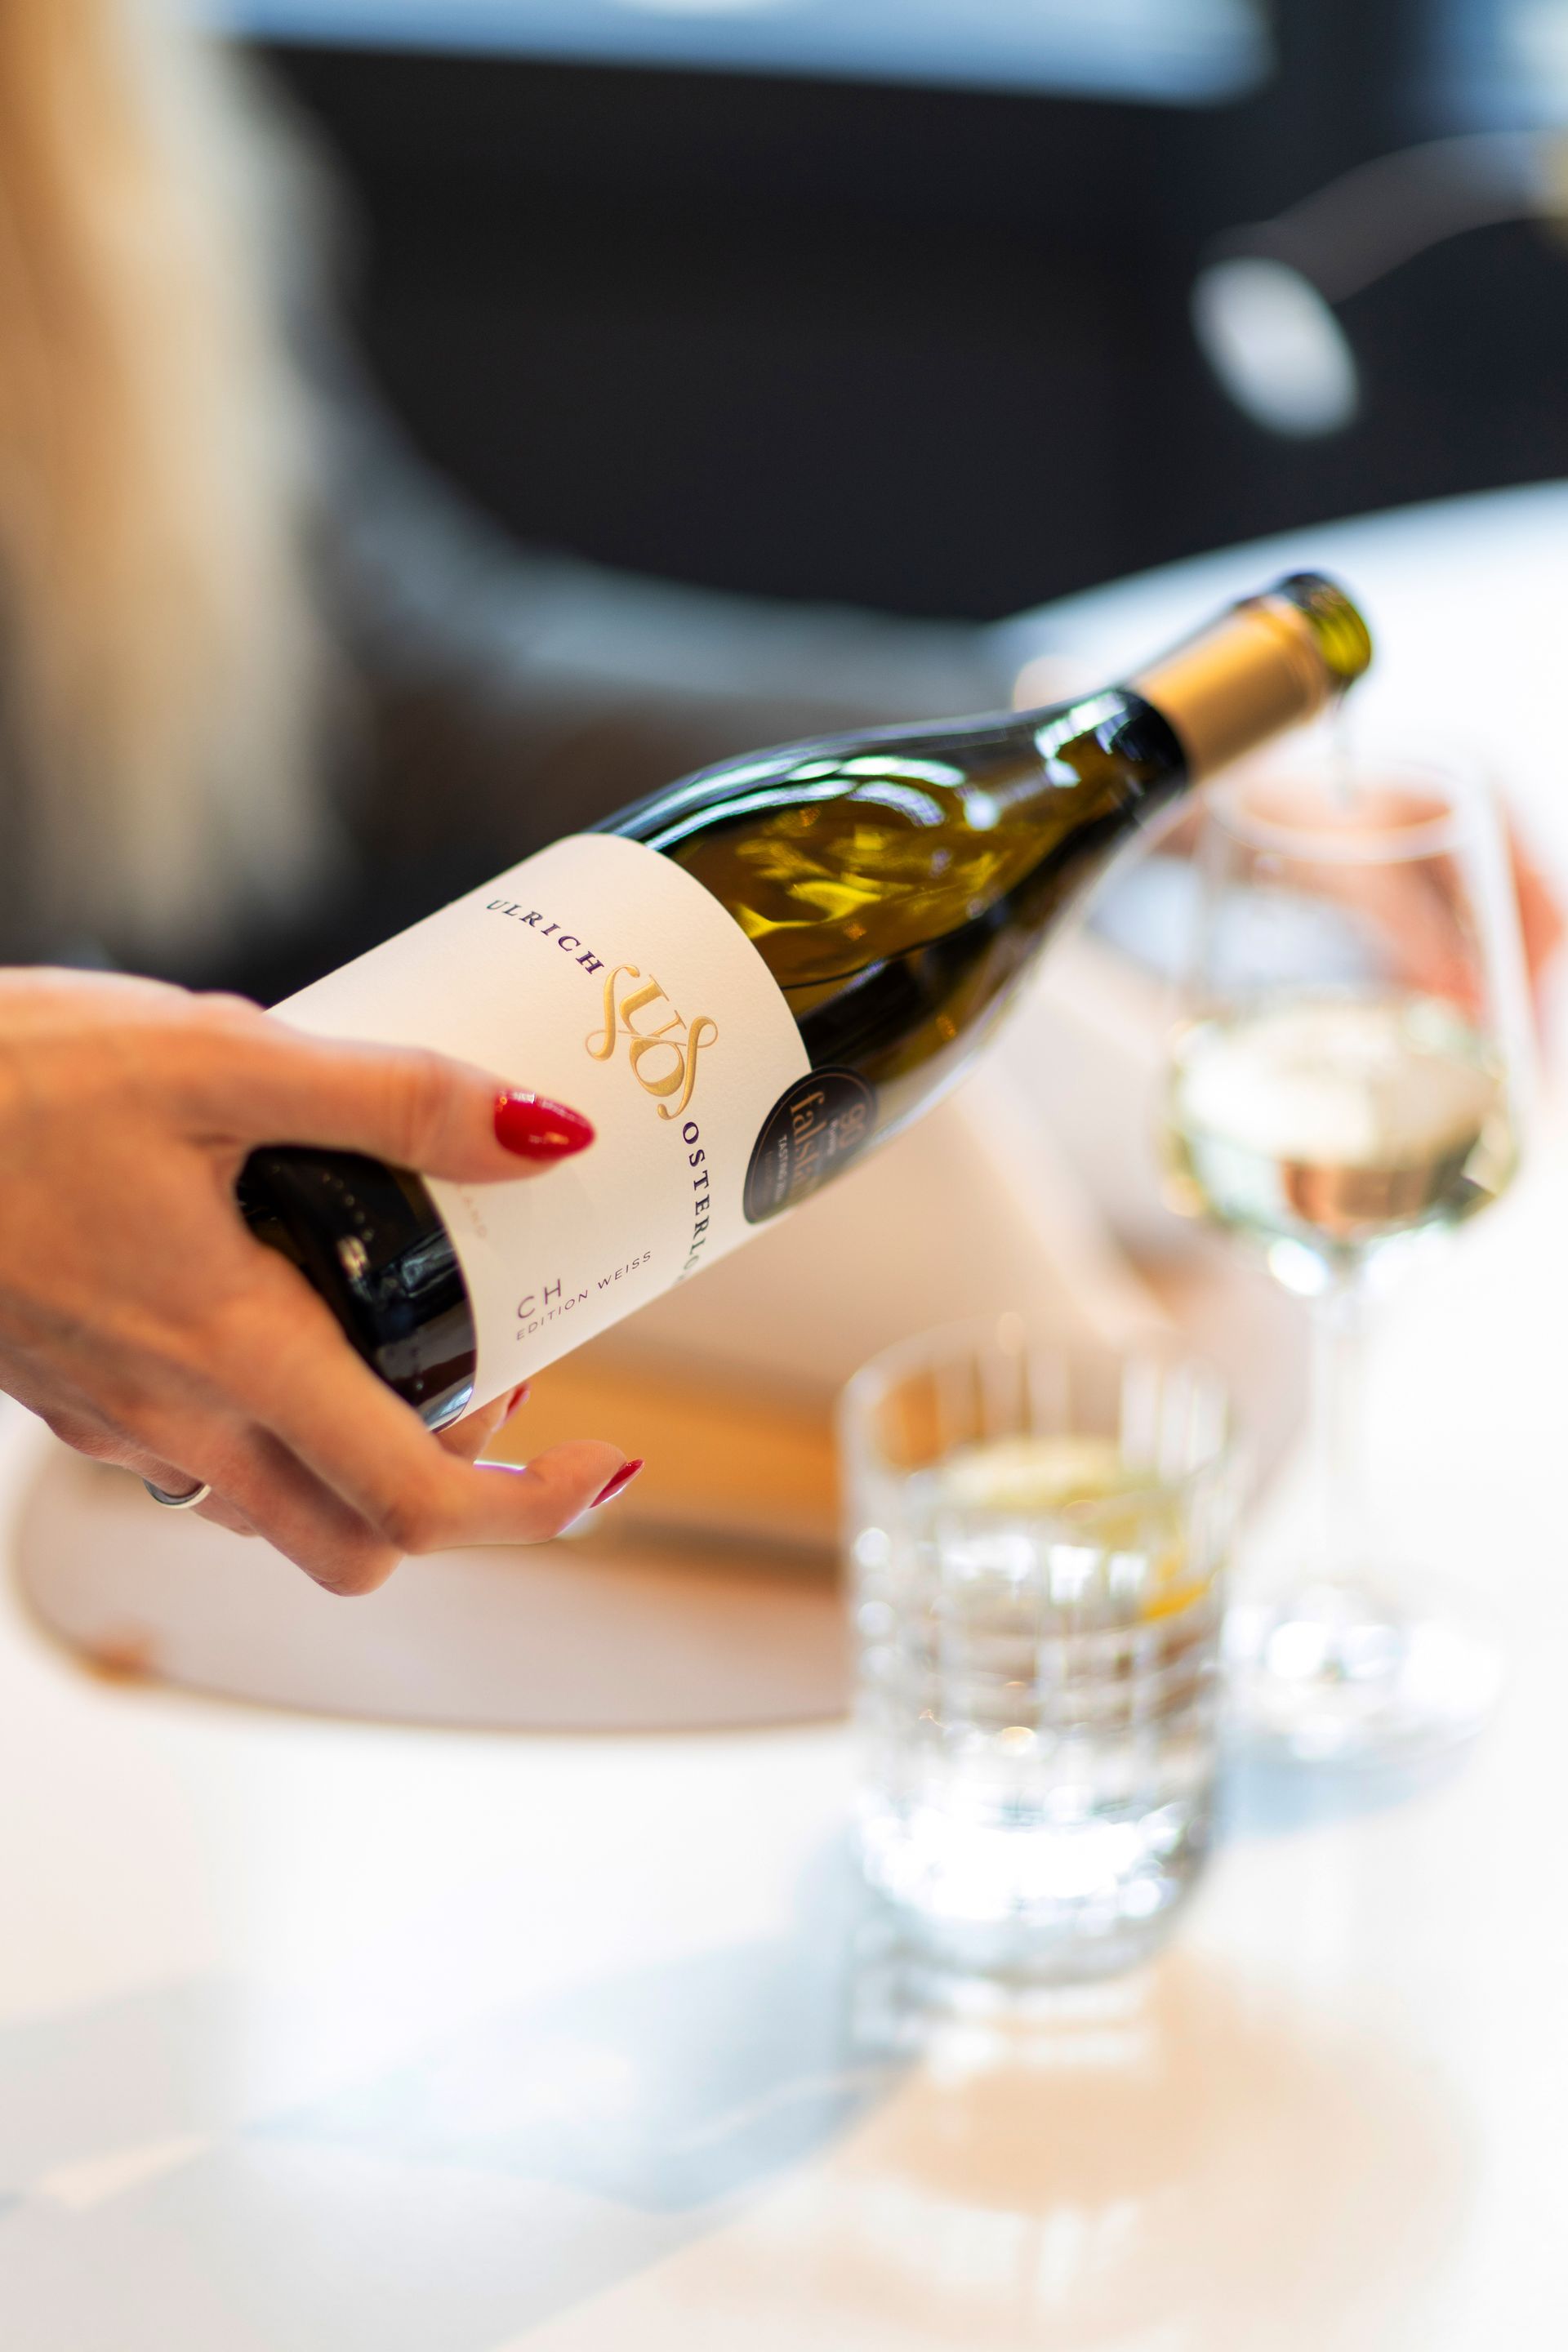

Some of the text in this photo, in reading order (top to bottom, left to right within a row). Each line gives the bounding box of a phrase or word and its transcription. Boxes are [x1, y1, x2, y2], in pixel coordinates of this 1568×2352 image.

[487, 900, 605, 974] ULRICH
[675, 1121, 710, 1280] OSTERLO
[516, 1251, 652, 1340] EDITION WEISS
[517, 1279, 562, 1320] CH
